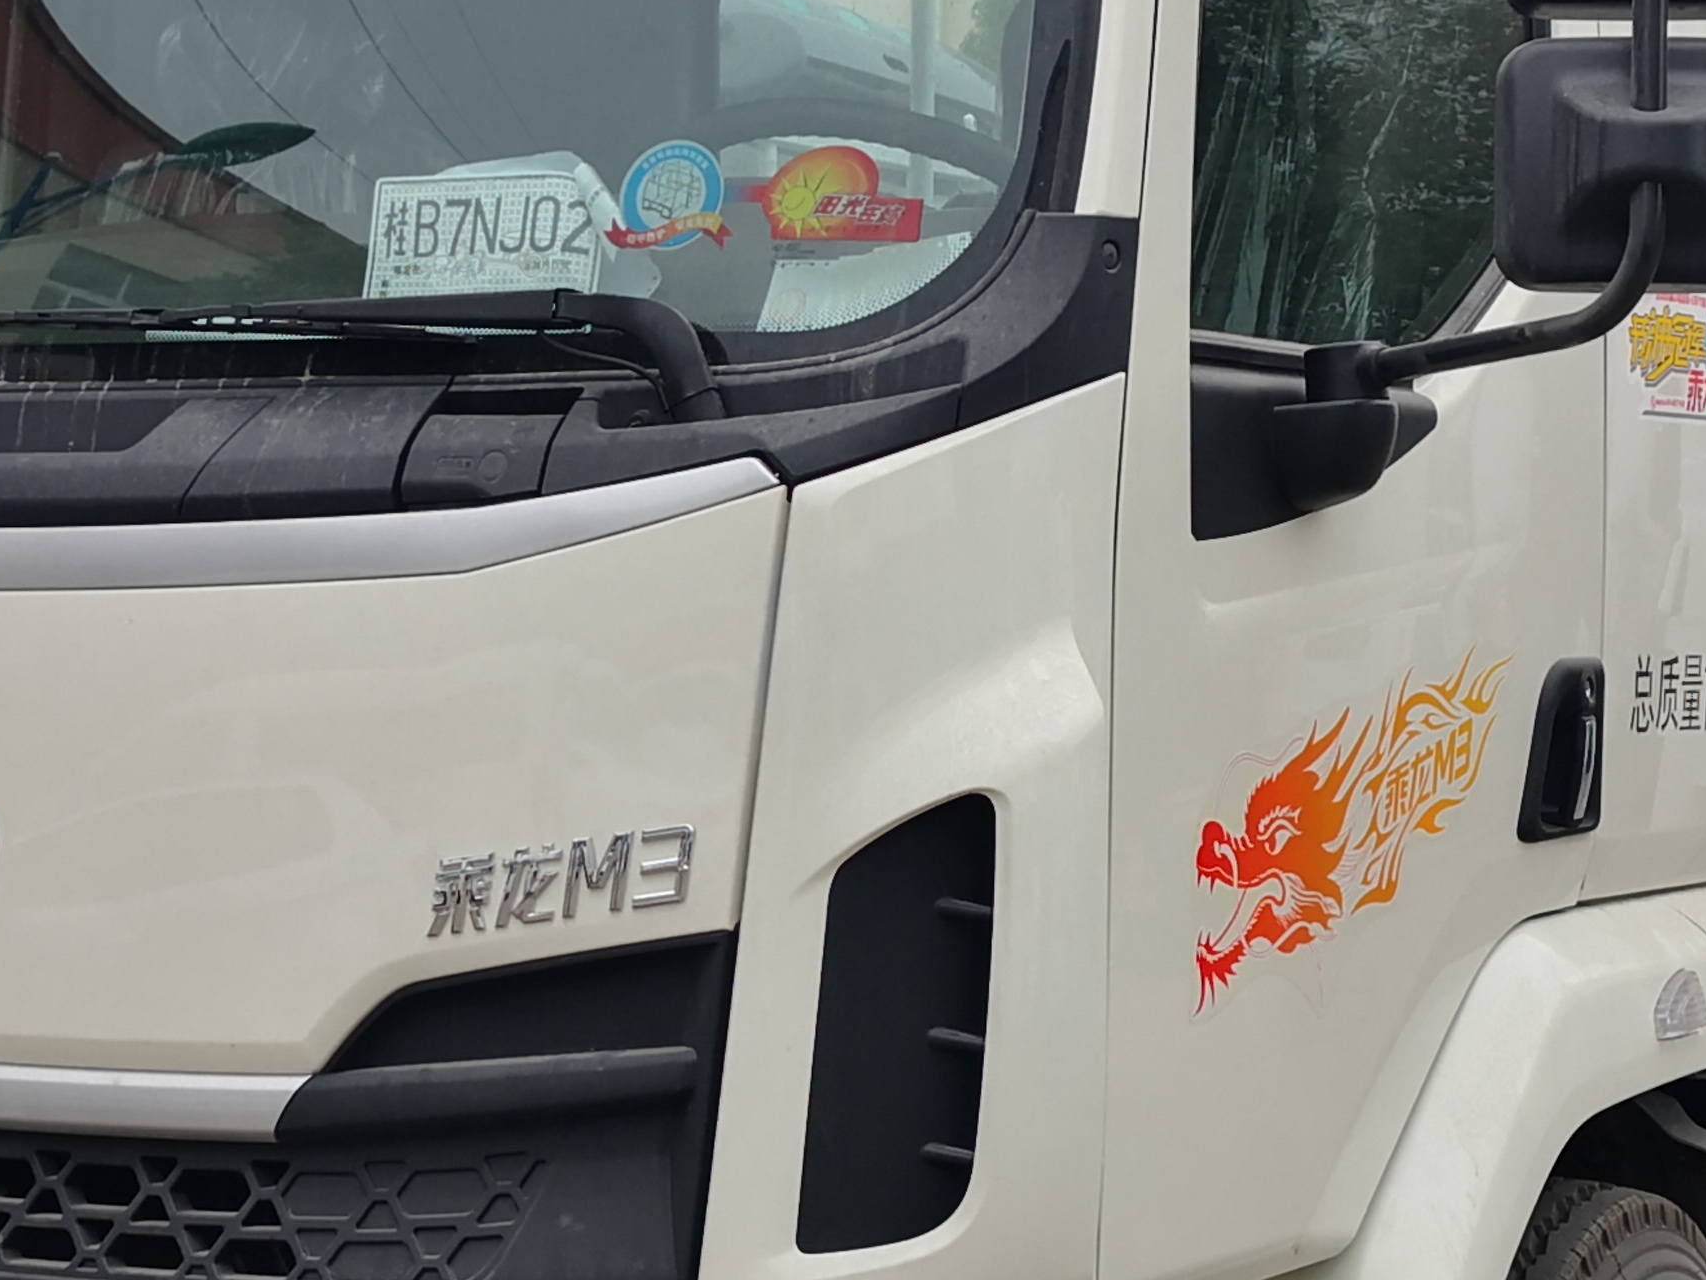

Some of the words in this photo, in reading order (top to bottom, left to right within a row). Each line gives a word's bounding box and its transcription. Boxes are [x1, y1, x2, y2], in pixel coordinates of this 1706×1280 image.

[384, 196, 592, 259] 桂B7NJ02
[1384, 718, 1474, 827] 乘龙M3
[427, 823, 696, 937] 乘龙M3
